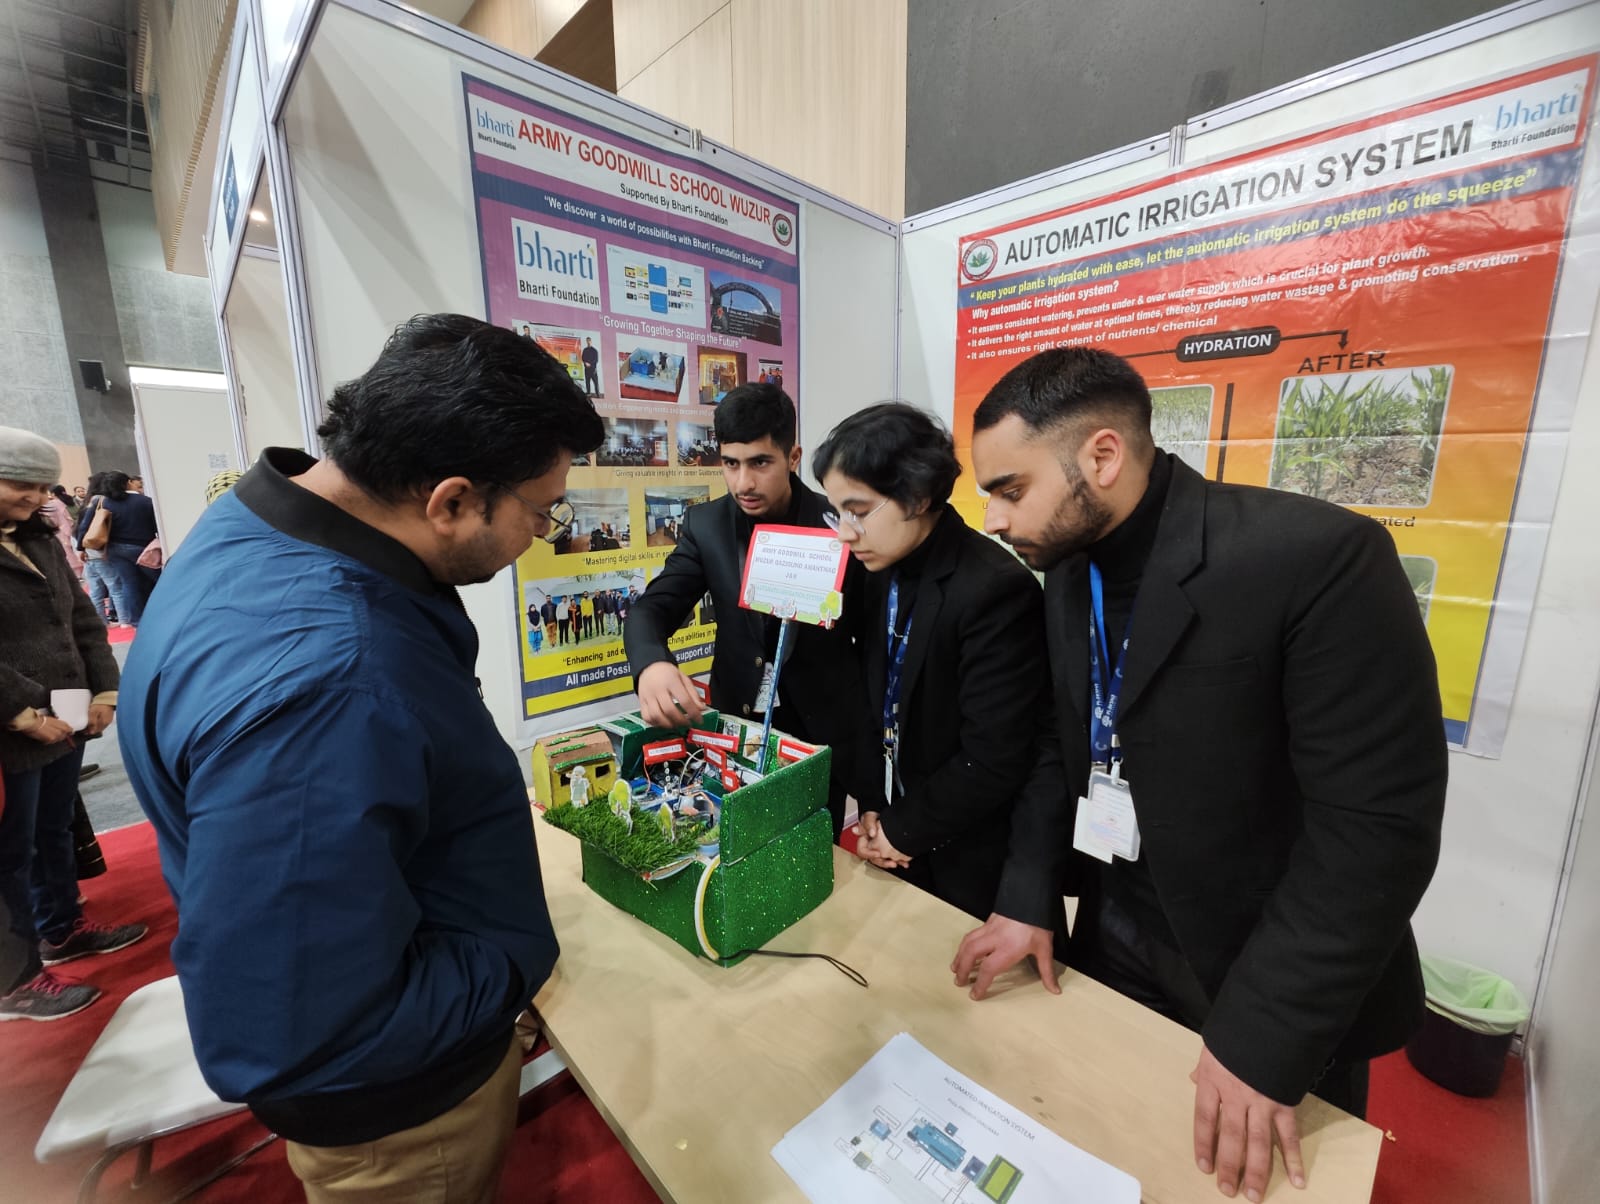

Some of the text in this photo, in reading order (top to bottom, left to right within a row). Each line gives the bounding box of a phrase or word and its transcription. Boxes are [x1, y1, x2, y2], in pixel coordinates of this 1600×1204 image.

[476, 107, 514, 137] bharti
[1496, 84, 1577, 131] bharti
[1490, 123, 1577, 151] Bharti Foundation
[518, 119, 770, 225] ARMY GOODWILL SCHOOL WUZUR
[1004, 212, 1130, 265] AUTOMATIC
[1138, 164, 1304, 232] IRRIGATION
[1315, 119, 1474, 188] SYSTEM
[620, 183, 728, 226] Supported By Bharti Foundation
[564, 202, 596, 220] discover
[601, 213, 606, 222] a
[607, 216, 627, 228] world
[629, 221, 636, 231] of
[637, 224, 676, 242] possibilities
[678, 235, 691, 246] with
[693, 238, 710, 251] Bharti
[711, 243, 741, 260] Foundation
[976, 290, 996, 300] Keep
[998, 286, 1016, 299] your
[1018, 279, 1045, 294] plants
[1048, 267, 1089, 288] hydrated
[1091, 262, 1112, 277] with
[1116, 257, 1143, 271] ease,
[1147, 251, 1162, 264] let
[1164, 246, 1183, 259] the
[1186, 232, 1250, 253] automatic
[1255, 219, 1319, 241] irrigation
[1324, 205, 1382, 229] system
[1387, 198, 1408, 214] do
[1413, 188, 1442, 209] the
[516, 226, 594, 280] bharti
[519, 280, 600, 306] Bharti Foundation
[972, 280, 1119, 320] Why automatic irrigation system?
[978, 335, 1003, 346] delivers
[1004, 333, 1015, 342] the
[1016, 329, 1032, 342] right
[1033, 326, 1060, 337] amount
[1061, 324, 1069, 333] of
[1070, 321, 1093, 332] water
[1094, 319, 1102, 328] at
[1104, 312, 1134, 328] optimal
[1136, 309, 1163, 321] times,
[1165, 303, 1201, 316] thereby
[1204, 295, 1248, 310] reducing
[1251, 291, 1282, 303] water
[1285, 282, 1334, 298] wastage
[1338, 278, 1347, 290] &
[1351, 267, 1418, 289] promoting
[1422, 253, 1519, 277] conservation
[979, 322, 1003, 333] ensures
[1004, 316, 1040, 329] consistent
[1041, 310, 1075, 322] watering,
[1076, 303, 1110, 318] prevents
[1111, 297, 1138, 309] under
[1146, 293, 1165, 303] over
[1168, 288, 1195, 299] water
[1197, 281, 1229, 295] supply
[1232, 276, 1263, 288] which
[1266, 273, 1276, 283] is
[1280, 265, 1320, 280] crucial
[1322, 262, 1339, 274] for
[1341, 255, 1375, 273] plant
[1378, 245, 1430, 267] growth.
[640, 321, 674, 336] Together
[675, 327, 705, 344] Shaping
[706, 334, 718, 344] the
[978, 349, 996, 359] also
[997, 346, 1032, 357] ensures
[1033, 340, 1054, 353] right
[1056, 335, 1093, 348] content
[1095, 332, 1106, 342] of
[1108, 324, 1160, 340] nutrients/
[1162, 315, 1218, 332] chemical
[1185, 334, 1272, 355] HYDRATION
[1298, 352, 1386, 374] AFTER
[619, 553, 636, 563] digital
[638, 552, 653, 561] skills
[566, 644, 711, 687] All made Possi support of
[607, 648, 618, 657] and
[685, 631, 705, 641] abilities
[1011, 1122, 1035, 1140] SYSTEM
